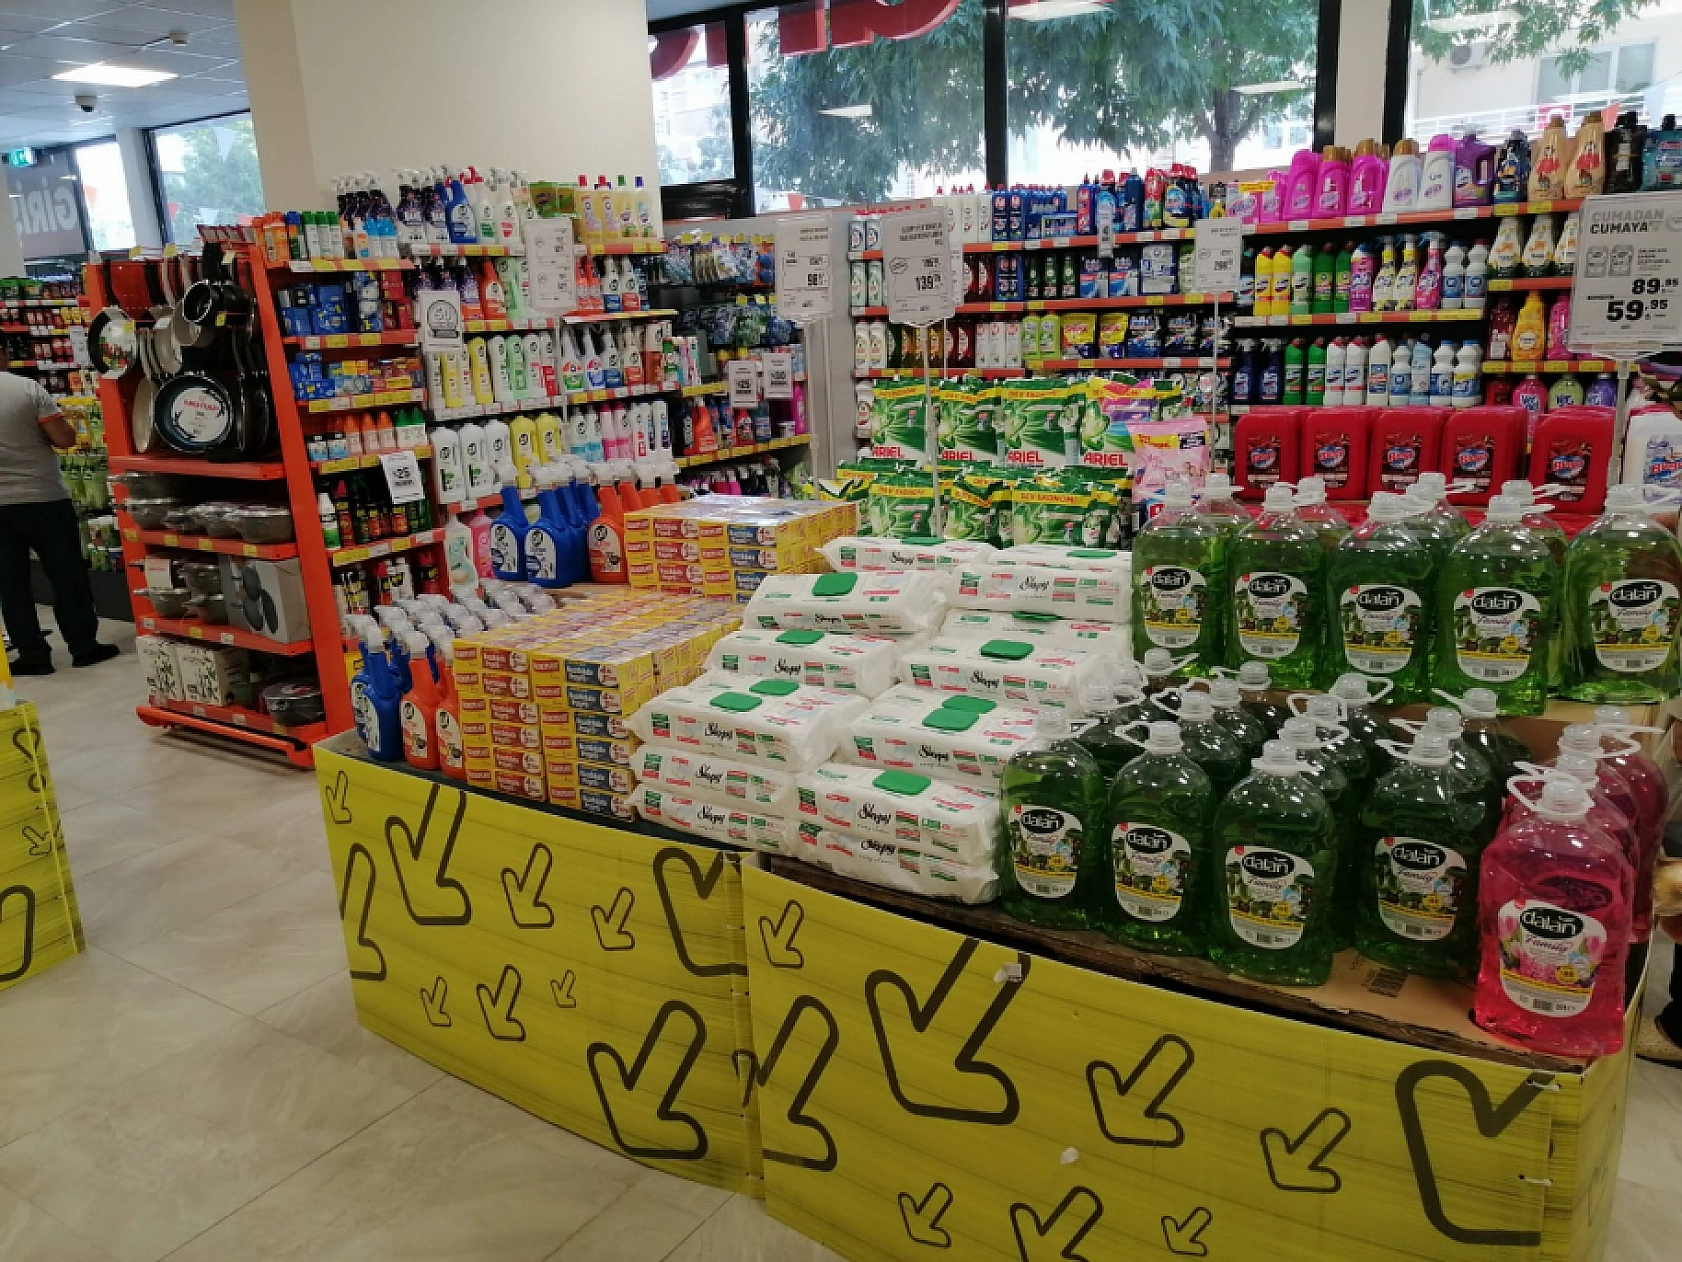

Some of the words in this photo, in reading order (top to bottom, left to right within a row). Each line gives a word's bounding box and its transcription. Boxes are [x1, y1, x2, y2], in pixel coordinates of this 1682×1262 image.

[1592, 208, 1665, 222] CUMADAN
[1590, 222, 1648, 235] CUMAYA
[1007, 450, 1044, 463] ARIEL
[1084, 452, 1129, 466] ARIEL
[1612, 584, 1658, 601] dalan
[1474, 594, 1518, 611] dalan
[1394, 846, 1440, 866] dalan
[1245, 856, 1289, 874] dalan
[1523, 911, 1577, 935] dalan
